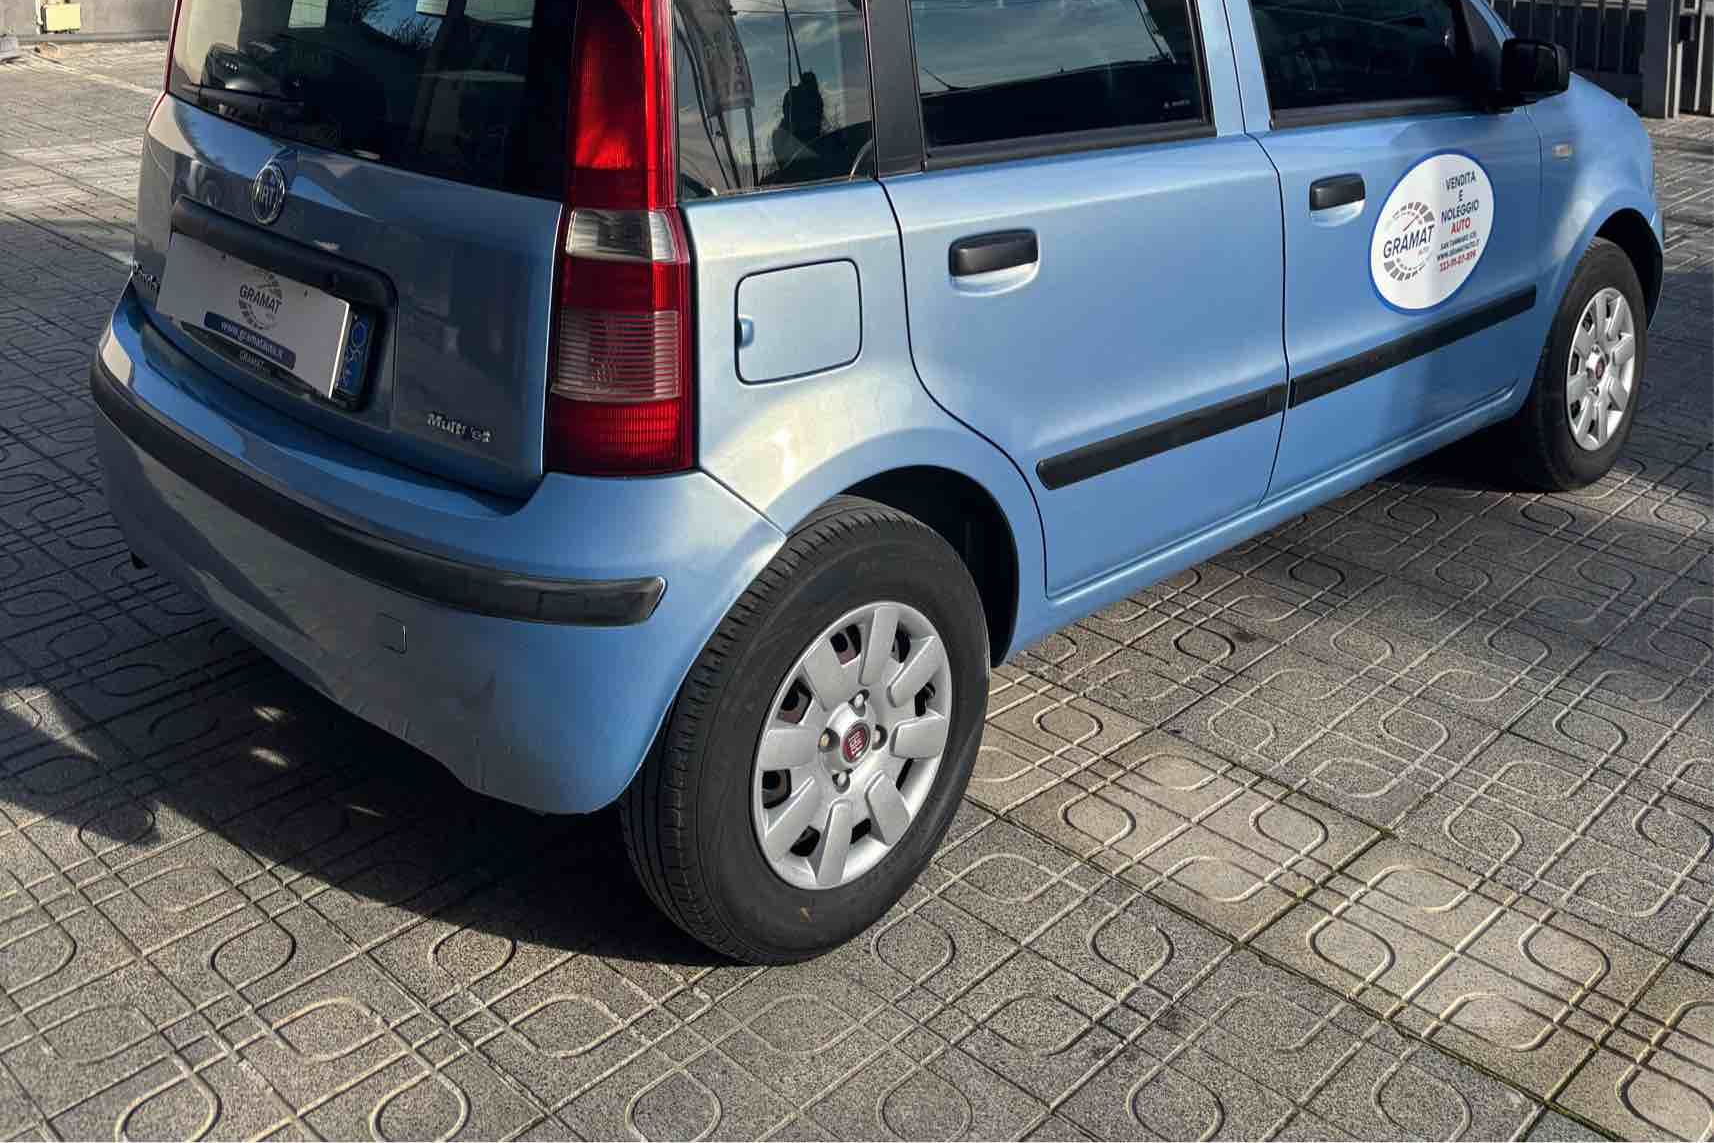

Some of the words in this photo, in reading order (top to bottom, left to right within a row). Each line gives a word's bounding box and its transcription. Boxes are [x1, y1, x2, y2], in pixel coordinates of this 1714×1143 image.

[1446, 171, 1476, 190] VENDITA
[1458, 189, 1464, 201] E
[1441, 199, 1479, 224] NOLEGGIO
[1450, 217, 1471, 235] AUTO
[1383, 224, 1434, 259] GRAMAT
[239, 284, 283, 315] GRAMAT
